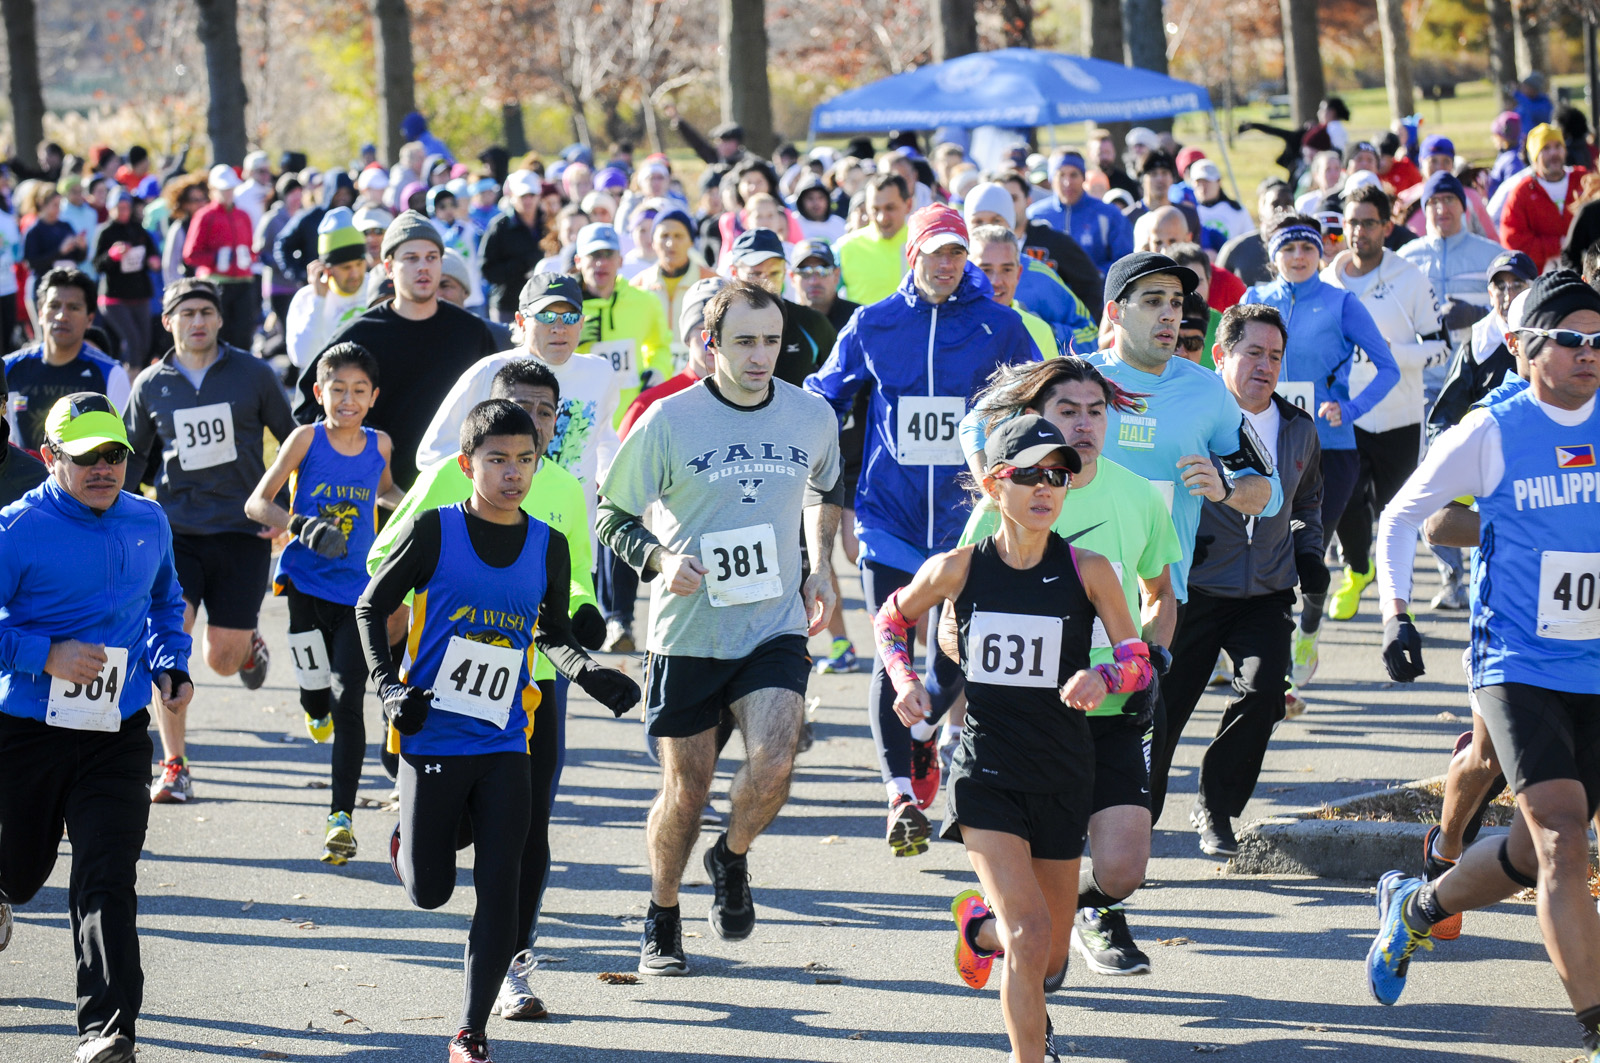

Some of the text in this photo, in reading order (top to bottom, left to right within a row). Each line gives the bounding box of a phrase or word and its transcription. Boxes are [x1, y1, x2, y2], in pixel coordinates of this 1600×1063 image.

[184, 418, 226, 448] 399
[907, 412, 955, 441] 405
[1119, 423, 1156, 443] HALF
[685, 441, 809, 475] YALE
[708, 463, 796, 483] BULLDOGS
[336, 485, 371, 501] WISH
[713, 540, 768, 582] 381
[1553, 572, 1600, 611] 40
[483, 609, 527, 632] WISH
[982, 633, 1044, 677] 631
[449, 658, 510, 701] 410
